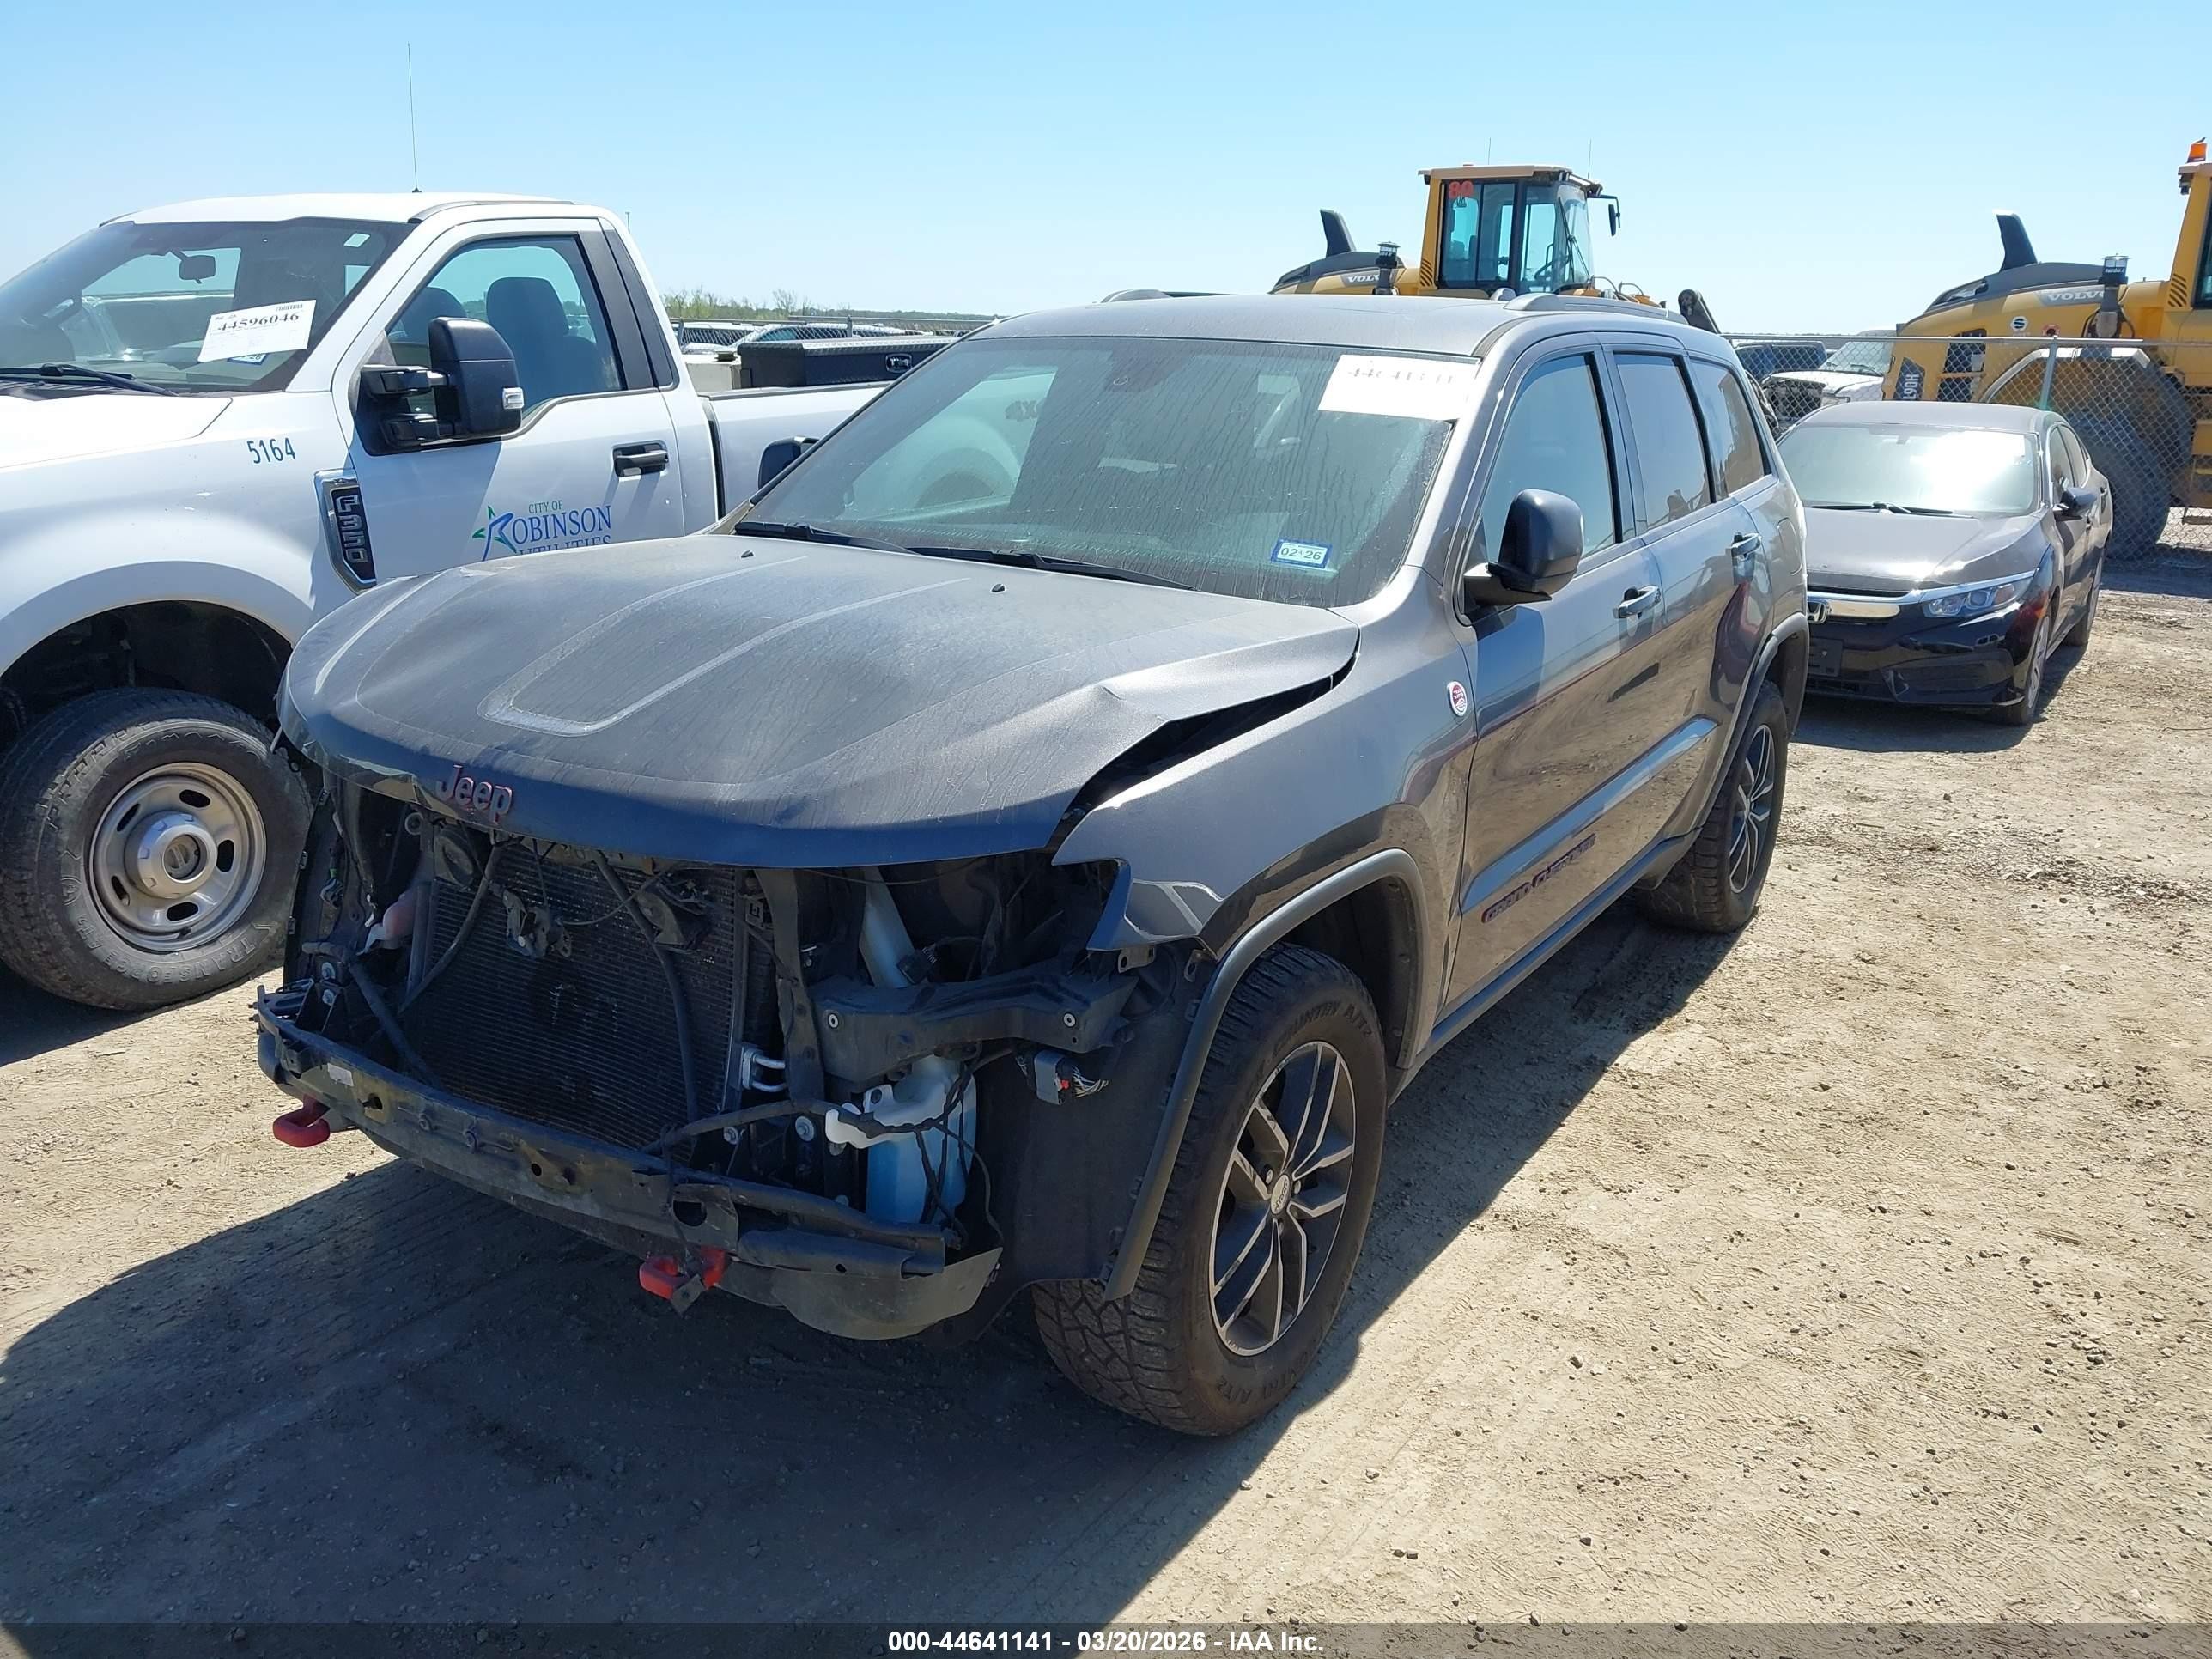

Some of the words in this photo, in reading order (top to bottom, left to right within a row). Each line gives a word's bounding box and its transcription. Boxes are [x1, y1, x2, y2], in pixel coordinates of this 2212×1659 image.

[217, 311, 300, 331] 44596046
[246, 437, 295, 464] 5164
[528, 501, 550, 514] CITY
[551, 500, 563, 511] OF
[435, 764, 514, 825] Jeep
